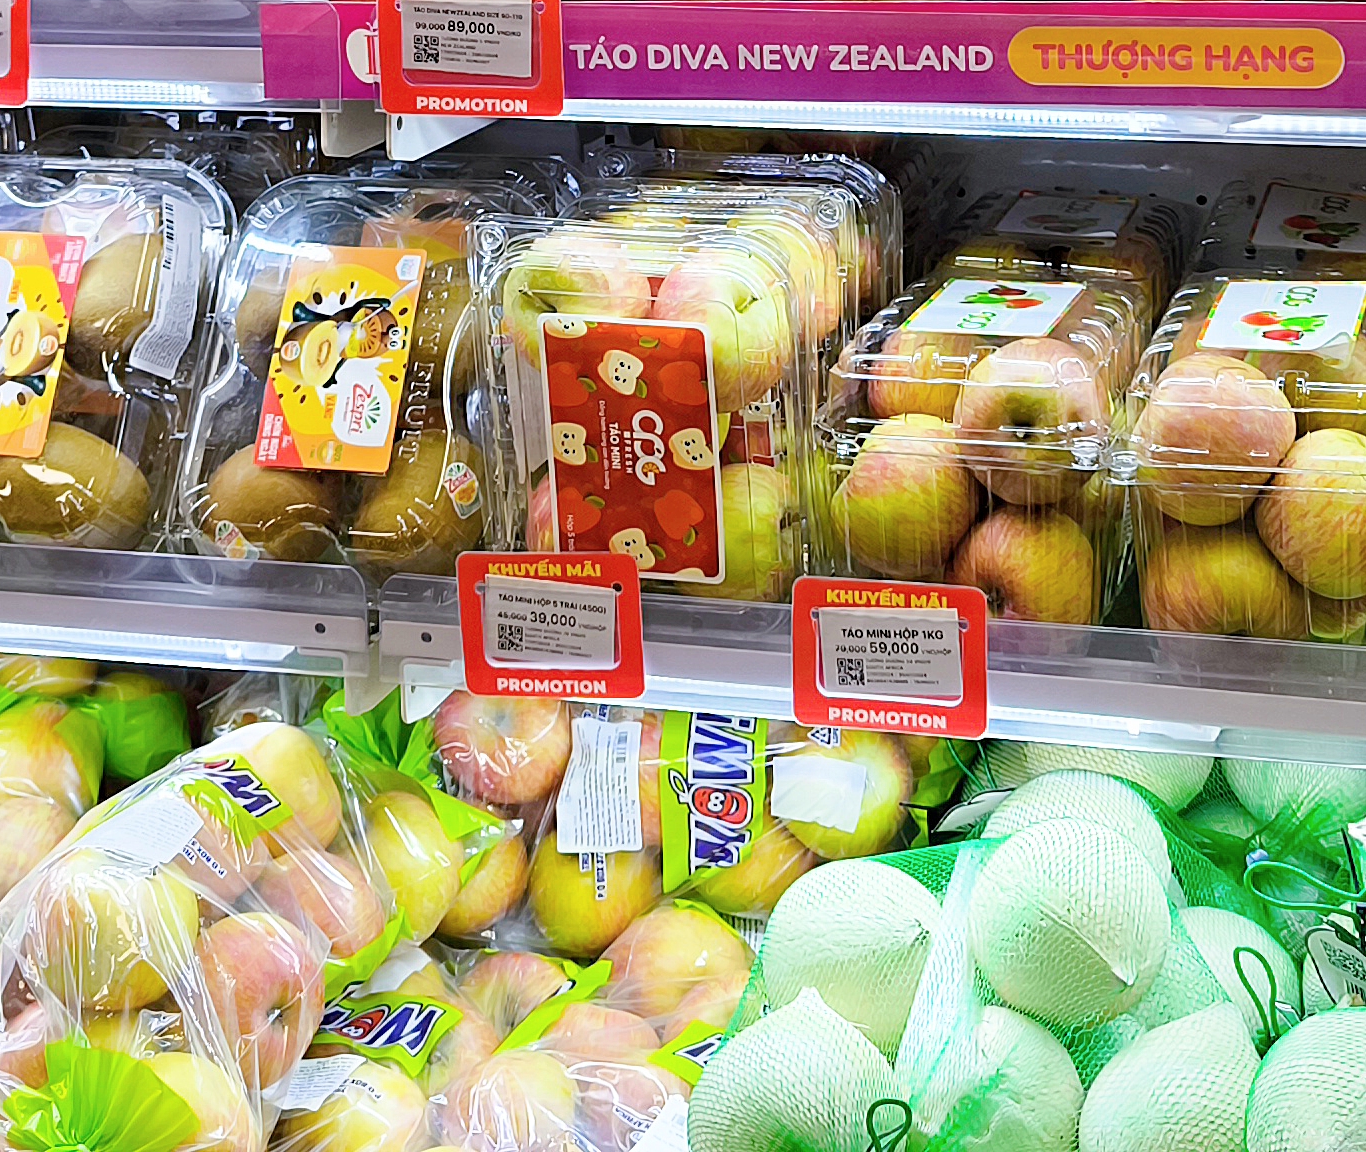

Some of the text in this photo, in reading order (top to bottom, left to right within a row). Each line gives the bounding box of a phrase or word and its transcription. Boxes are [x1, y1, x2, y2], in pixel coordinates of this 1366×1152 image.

[415, 20, 495, 35] 99,000 89,000
[569, 36, 1314, 82] TÁO DIVA NEW ZEALAND THƯỢNG HẠNG
[417, 96, 527, 113] PROMOTION
[348, 383, 374, 434] Zespri
[609, 422, 621, 470] TÁO MINI
[489, 559, 601, 577] KHUYẾN MÃI
[499, 593, 513, 602] TÁO
[534, 597, 551, 608] HỘP
[827, 588, 947, 608] KHUYẾN MÃI
[530, 612, 576, 627] 39,000
[841, 627, 943, 642] TÁO MINI HỘP 1KG
[869, 642, 918, 656] 59,000
[497, 678, 607, 694] PROMOTION
[829, 707, 947, 728] PROMOTION
